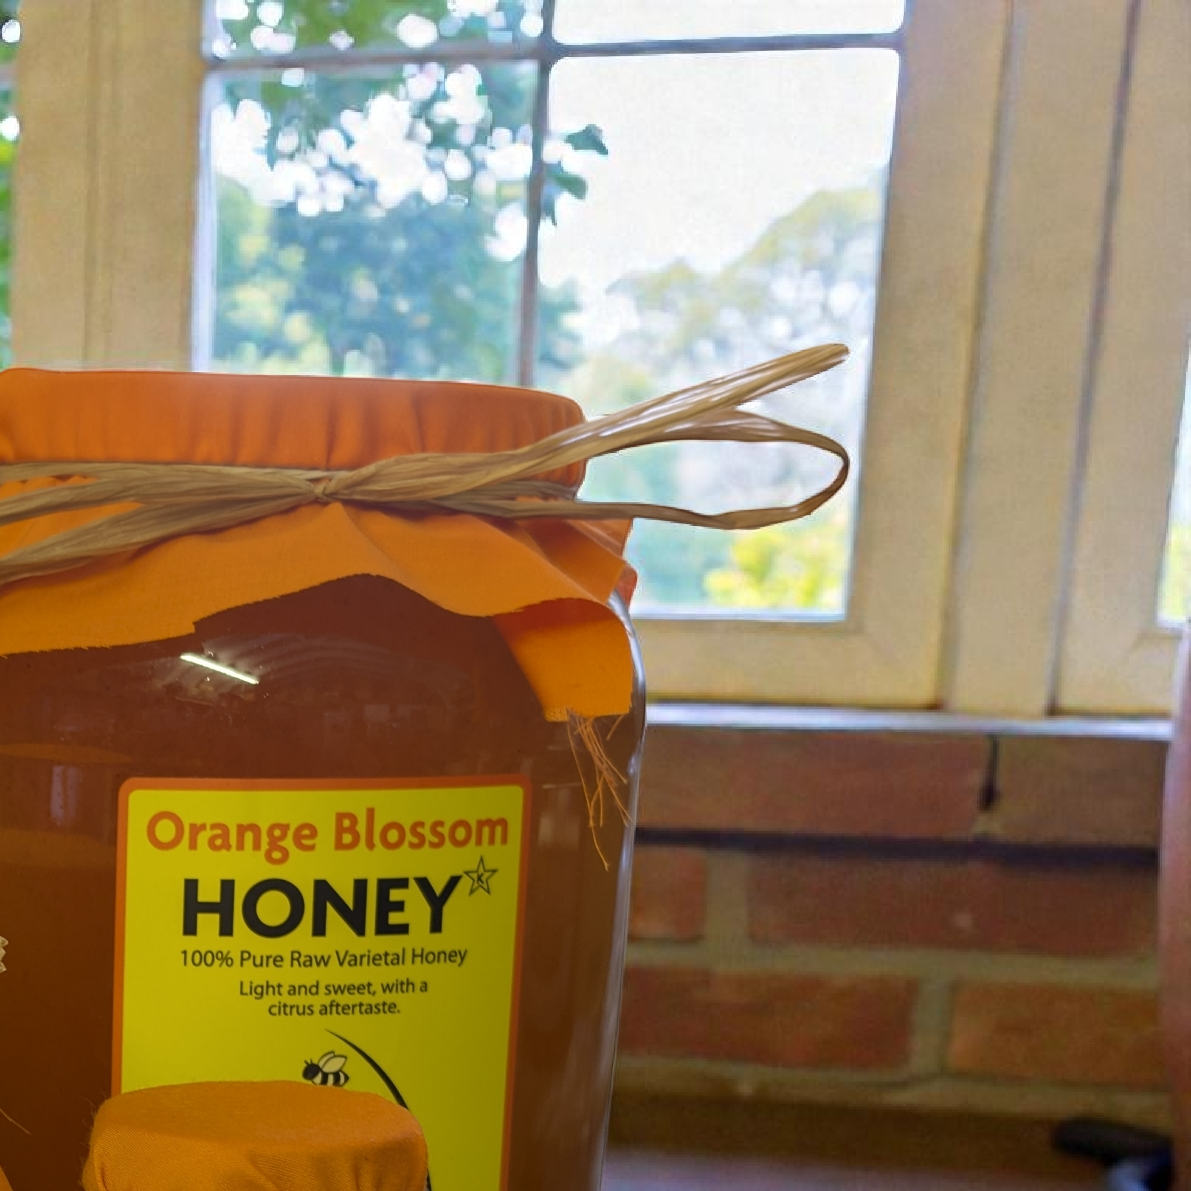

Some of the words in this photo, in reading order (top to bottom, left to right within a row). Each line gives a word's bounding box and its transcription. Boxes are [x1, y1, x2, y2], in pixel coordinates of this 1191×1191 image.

[146, 811, 318, 866] Orange
[334, 807, 508, 851] Blossom
[476, 874, 484, 884] K
[182, 875, 463, 939] HONEY
[180, 950, 233, 968] 100%
[239, 950, 284, 968] Pure
[290, 952, 330, 968] Raw
[335, 948, 406, 967] Varietal
[411, 947, 467, 967] Honey
[239, 980, 284, 999] Light
[288, 980, 319, 996] and
[324, 981, 377, 997] sweet,
[380, 978, 415, 994] with
[419, 982, 428, 994] a
[268, 1002, 314, 1017] citrus
[318, 1000, 401, 1016] aftertaste.
